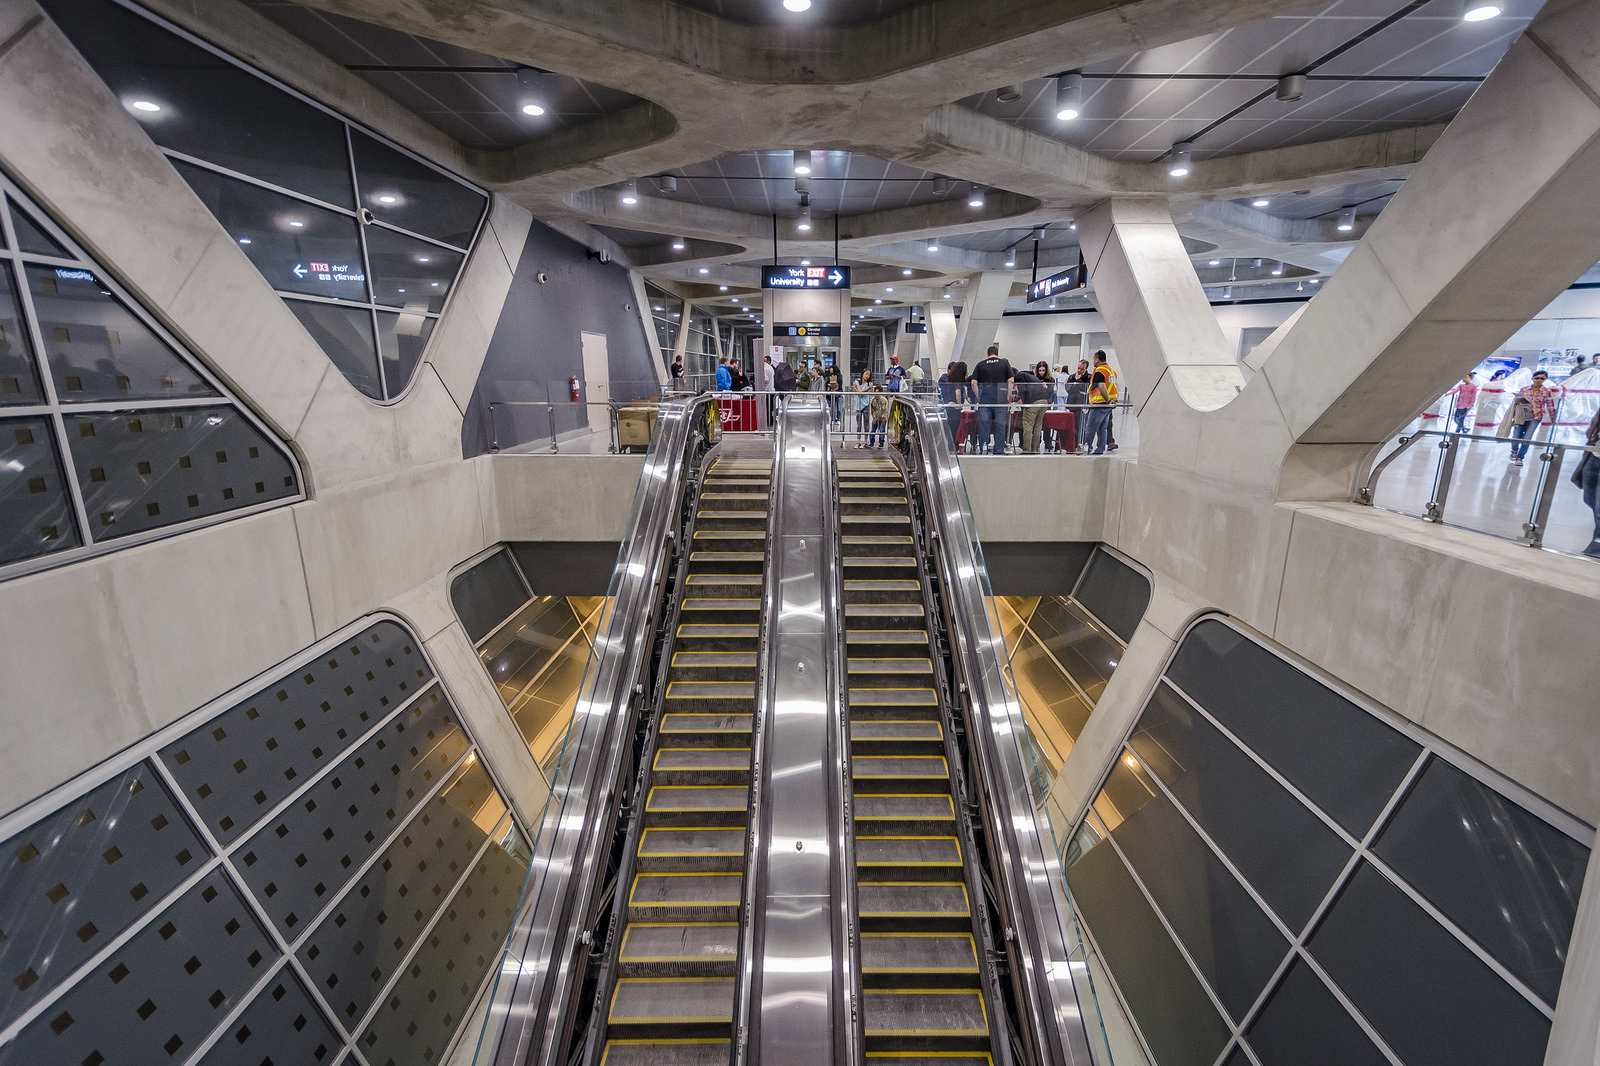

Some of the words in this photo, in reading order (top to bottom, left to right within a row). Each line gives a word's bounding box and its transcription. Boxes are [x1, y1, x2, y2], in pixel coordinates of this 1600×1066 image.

[788, 268, 804, 276] York
[807, 268, 824, 278] EXIT
[770, 278, 804, 286] University
